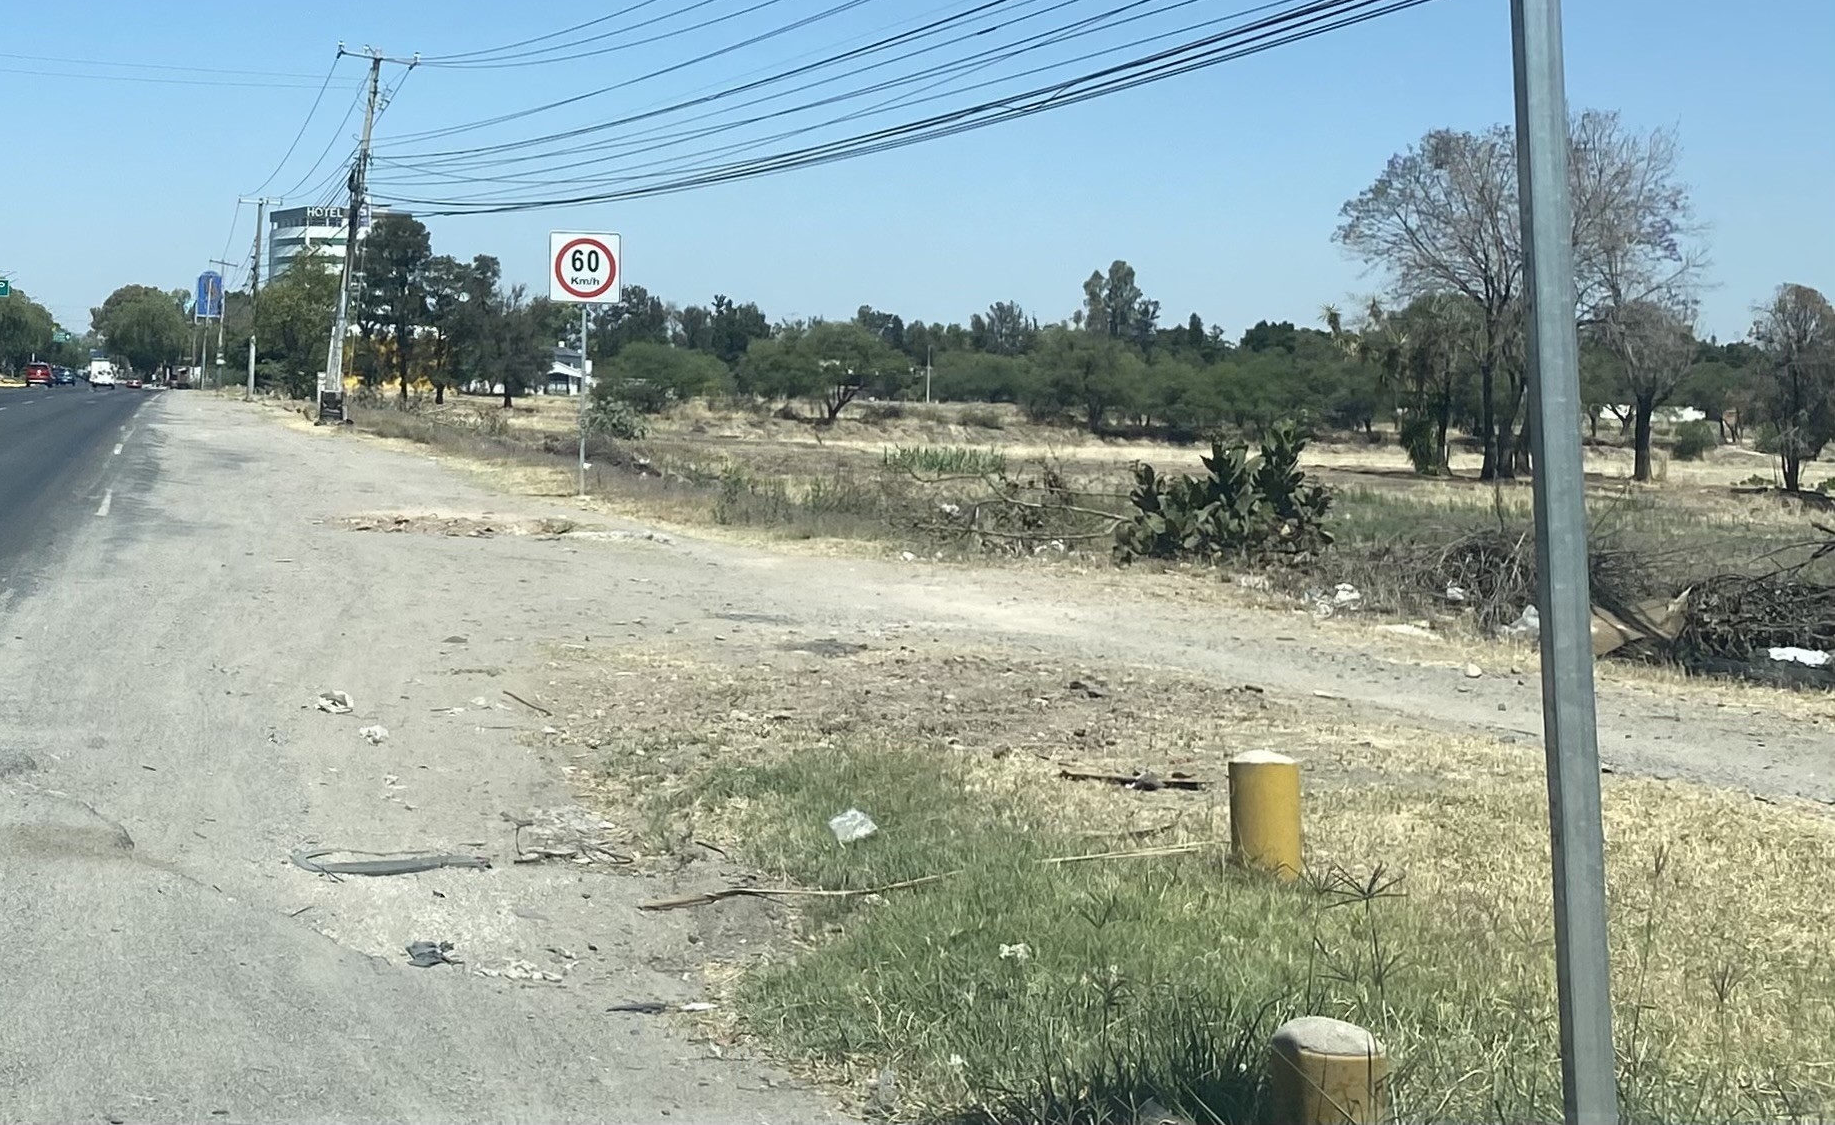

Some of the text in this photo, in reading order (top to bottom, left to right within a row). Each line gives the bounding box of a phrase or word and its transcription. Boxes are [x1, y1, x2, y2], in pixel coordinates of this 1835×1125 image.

[306, 207, 343, 218] HOTEL
[571, 249, 599, 273] 60
[570, 276, 600, 285] Km/h
